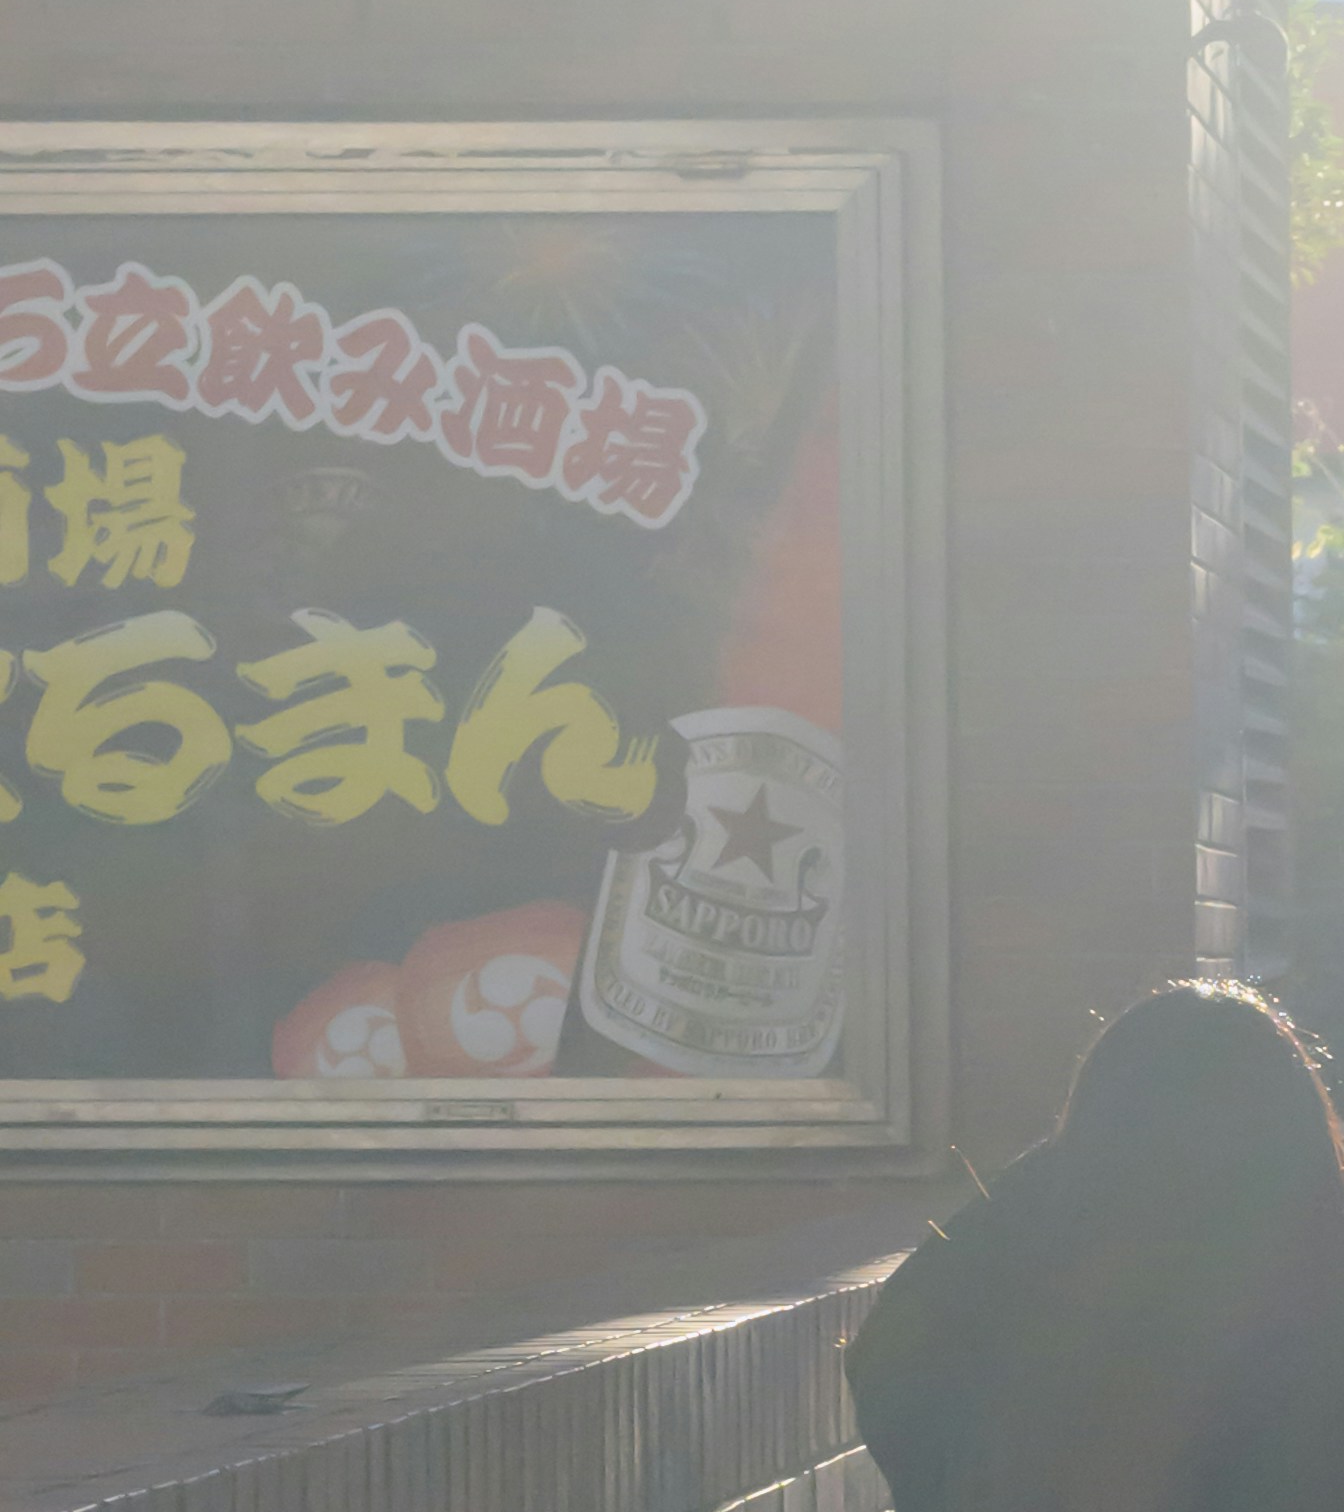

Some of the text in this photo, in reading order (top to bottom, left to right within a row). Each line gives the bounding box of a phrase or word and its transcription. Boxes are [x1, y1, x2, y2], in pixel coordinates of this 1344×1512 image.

[0, 433, 196, 588] 場
[0, 606, 659, 827] るまん
[652, 884, 814, 951] SAPPORO
